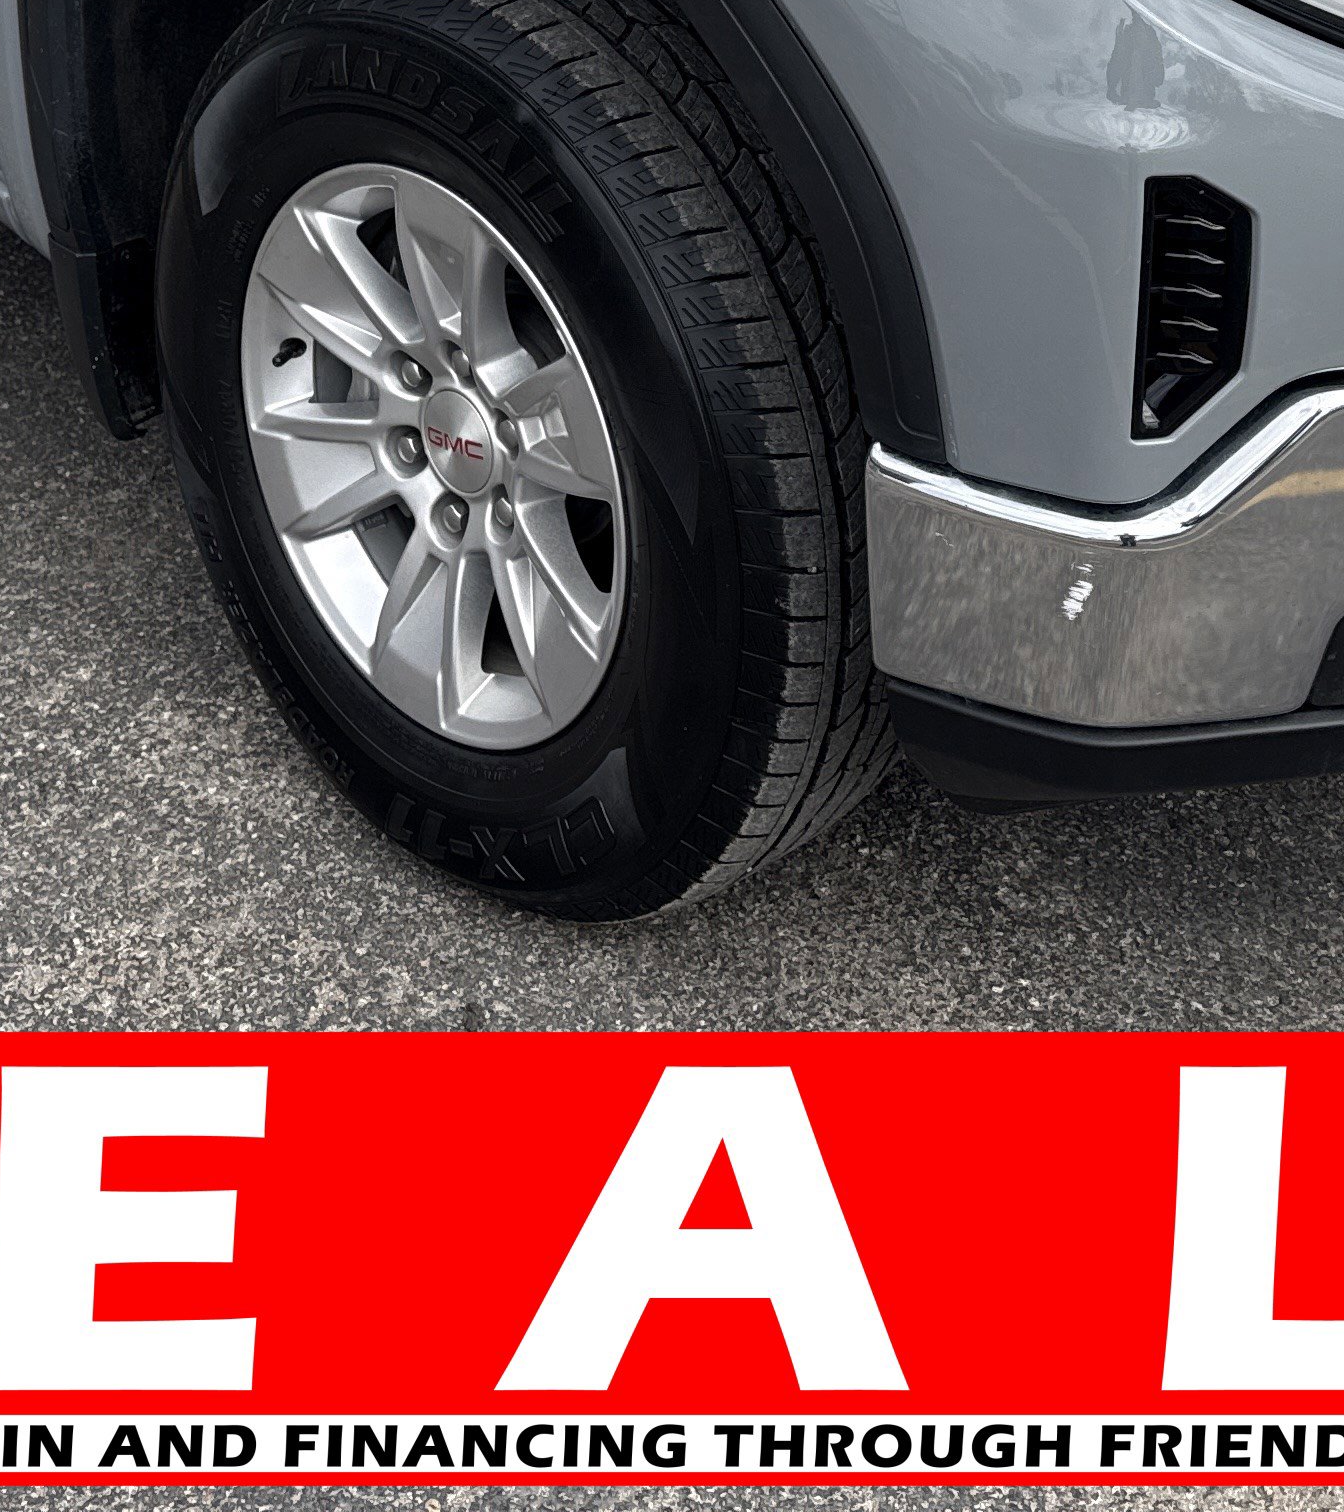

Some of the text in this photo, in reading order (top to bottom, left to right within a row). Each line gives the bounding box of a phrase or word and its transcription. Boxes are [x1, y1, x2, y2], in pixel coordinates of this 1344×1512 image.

[275, 44, 572, 236] LANDSAIL
[427, 426, 484, 461] GMC
[383, 791, 616, 882] CLX-11
